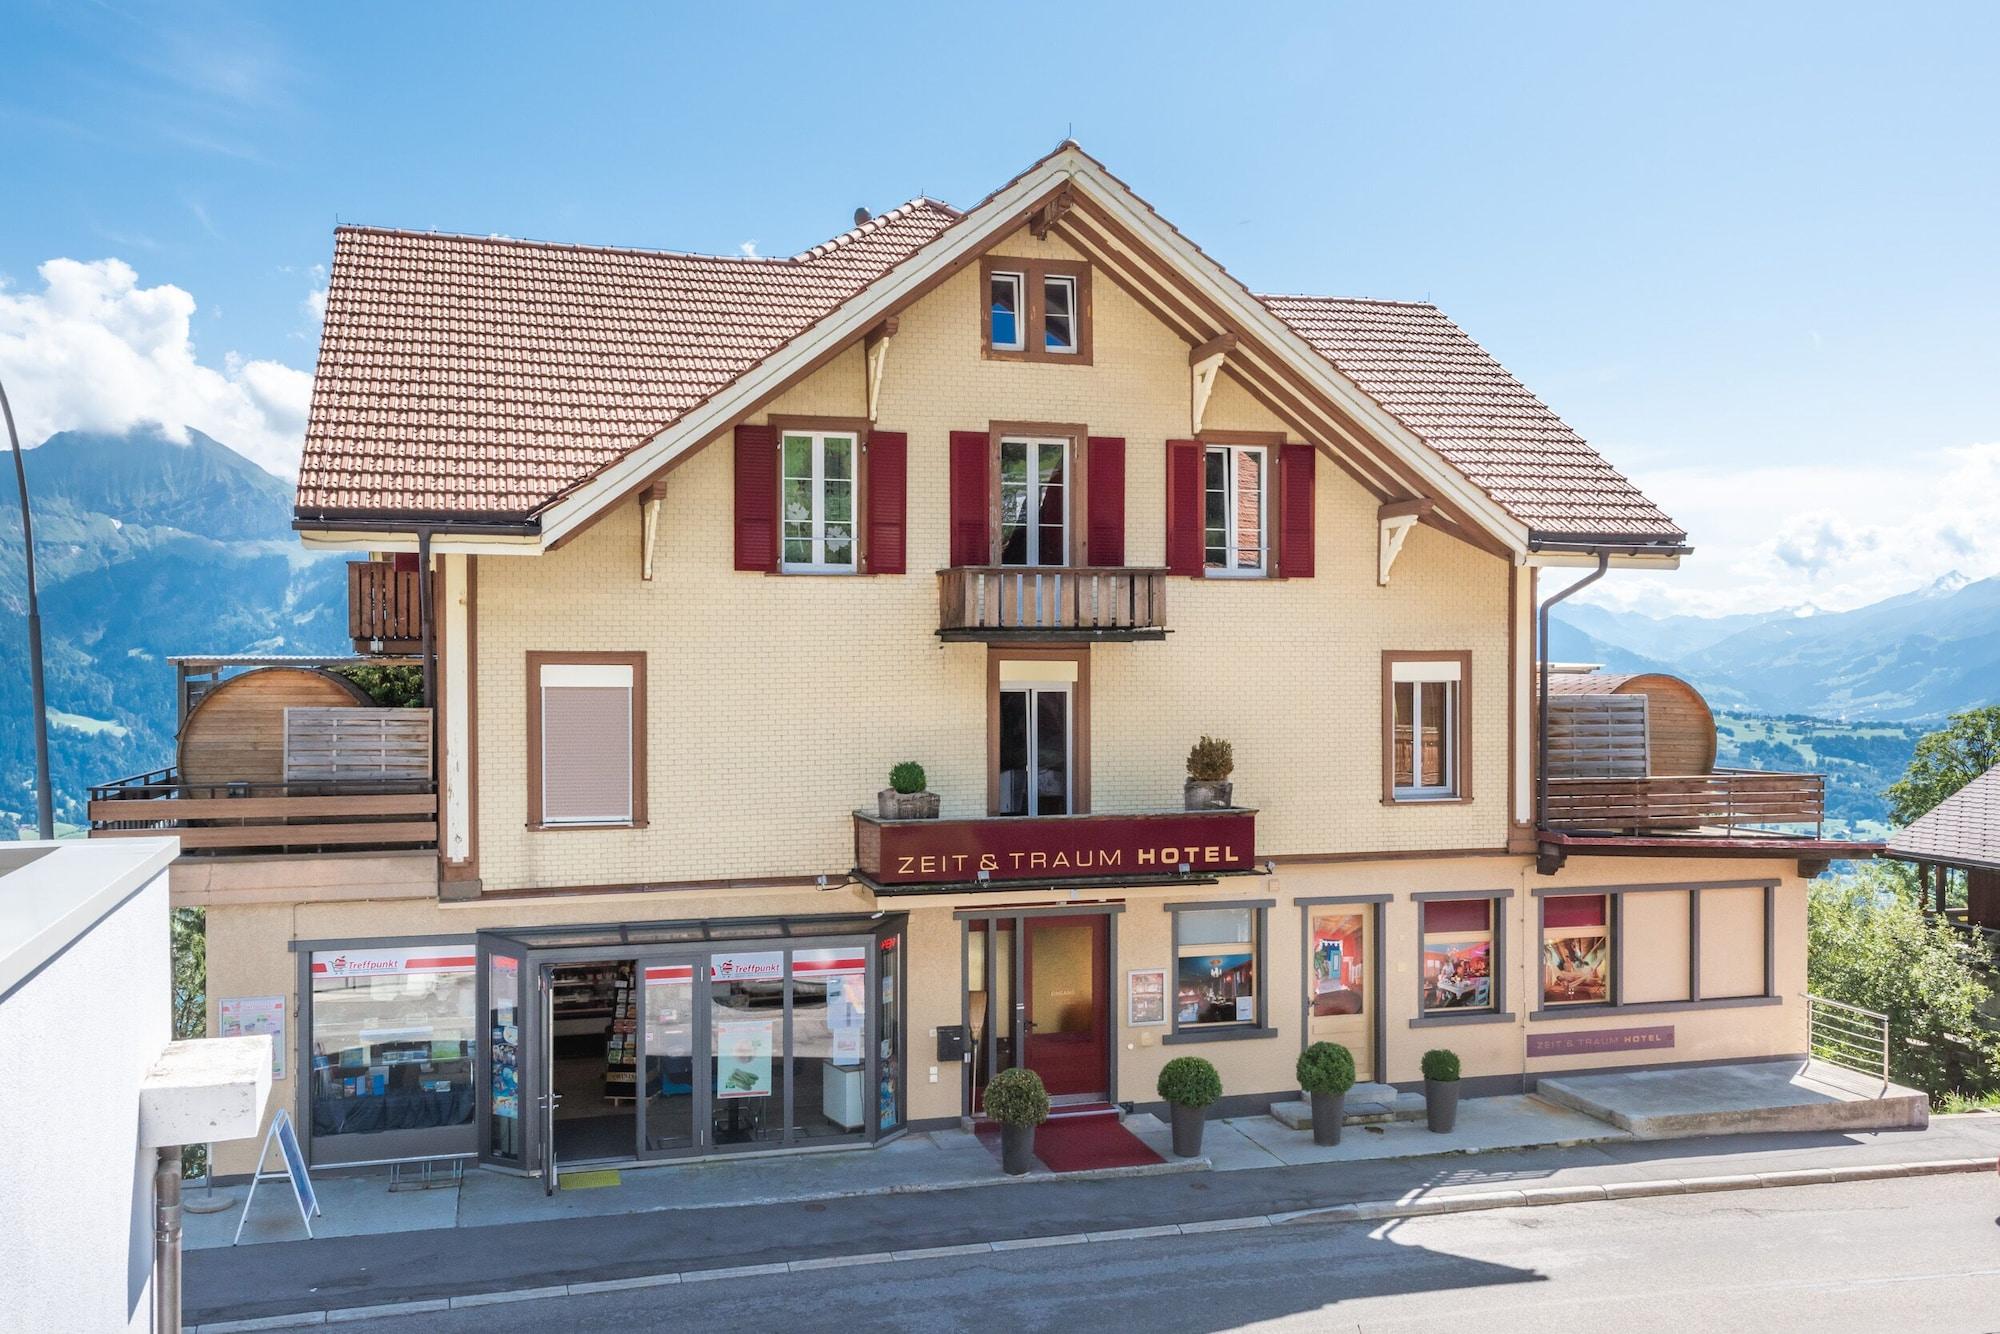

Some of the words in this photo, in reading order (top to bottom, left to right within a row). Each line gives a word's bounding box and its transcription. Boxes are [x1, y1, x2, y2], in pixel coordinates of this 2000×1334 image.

[898, 855, 969, 874] ZEIT
[979, 853, 999, 870] &
[1009, 850, 1121, 869] TRAUM
[1138, 846, 1239, 865] HOTEL
[348, 960, 399, 970] Treffpunkt
[735, 964, 780, 974] Treffpunkt
[1537, 1040, 1562, 1049] ZEIT
[1579, 1036, 1618, 1047] TRAUM
[1624, 1034, 1661, 1043] HOTEL
